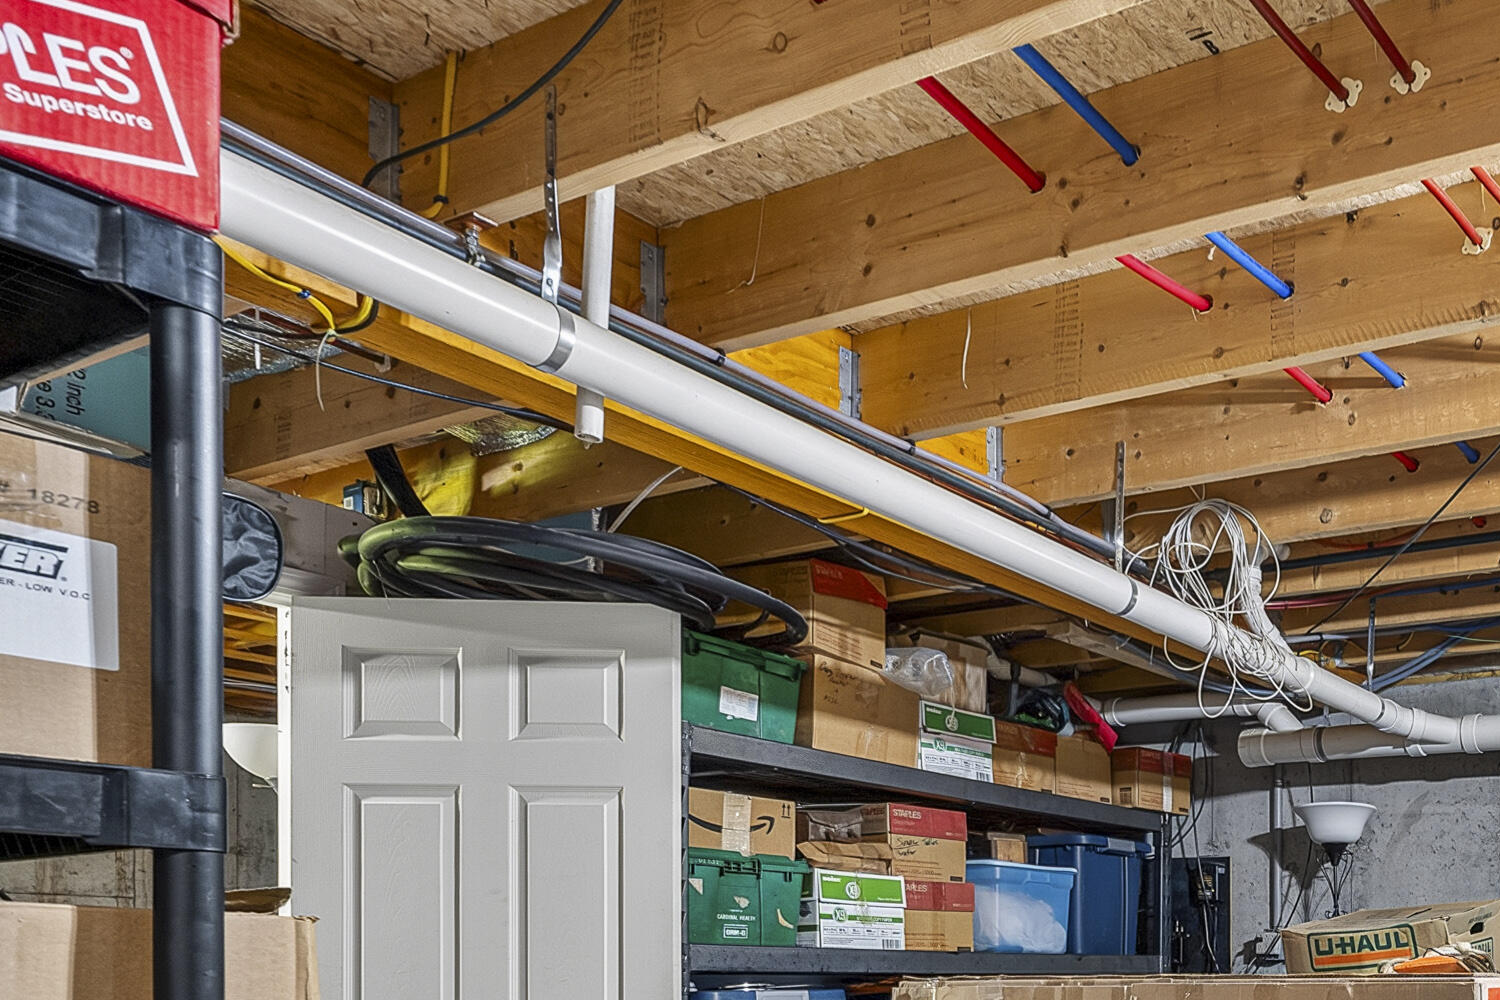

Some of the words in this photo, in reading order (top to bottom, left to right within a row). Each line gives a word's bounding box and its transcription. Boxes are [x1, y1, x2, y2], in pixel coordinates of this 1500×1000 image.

[0, 22, 141, 104] LES
[3, 82, 154, 131] Superstore
[65, 382, 87, 417] inch
[27, 488, 100, 515] 18278
[0, 540, 64, 581] ER
[25, 582, 53, 594] LOW
[892, 808, 922, 820] STAPLES
[905, 883, 928, 893] APLES
[716, 913, 738, 921] CARDINAL
[1314, 931, 1409, 957] U-HAUL
